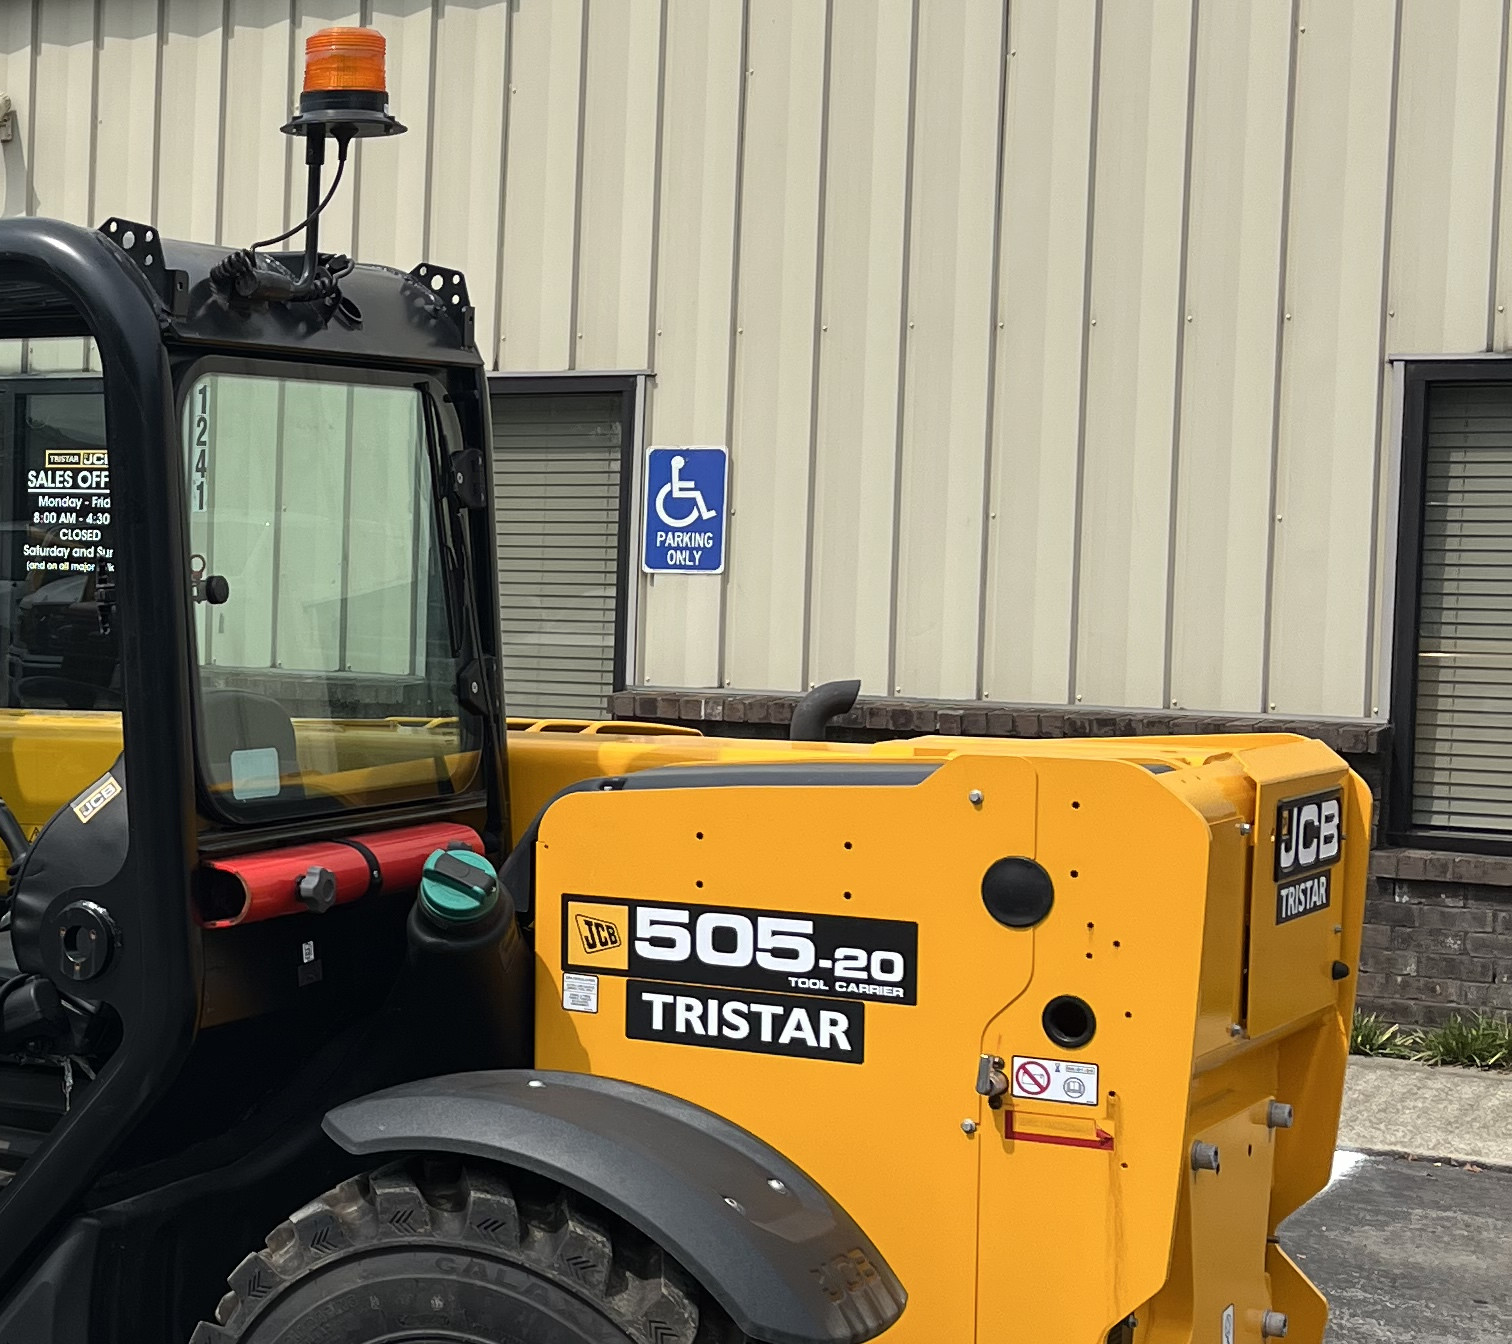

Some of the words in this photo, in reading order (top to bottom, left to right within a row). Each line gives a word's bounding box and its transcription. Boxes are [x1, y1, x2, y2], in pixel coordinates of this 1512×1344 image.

[195, 384, 208, 511] 1241
[49, 455, 79, 463] TRISTAR
[28, 470, 73, 488] SALES
[77, 470, 109, 488] OFF
[38, 496, 82, 509] Monday
[33, 512, 56, 524] 8:00
[59, 513, 76, 524] AM
[86, 513, 110, 525] 4:30
[59, 528, 101, 541] CLOSED
[656, 531, 713, 548] PARKING
[23, 544, 70, 558] Saturday
[72, 546, 94, 558] and
[667, 550, 702, 566] ONLY
[26, 561, 45, 571] (and
[47, 562, 57, 570] on
[59, 561, 69, 571] all
[71, 562, 95, 573] major
[80, 784, 116, 816] JCB
[1280, 799, 1340, 870] JCB
[1280, 876, 1327, 919] TRISTAR
[583, 919, 619, 949] JCB
[634, 906, 905, 982] 505-20
[788, 976, 829, 991] TOOL
[835, 981, 905, 998] CARRIER
[642, 992, 852, 1051] TRISTAR
